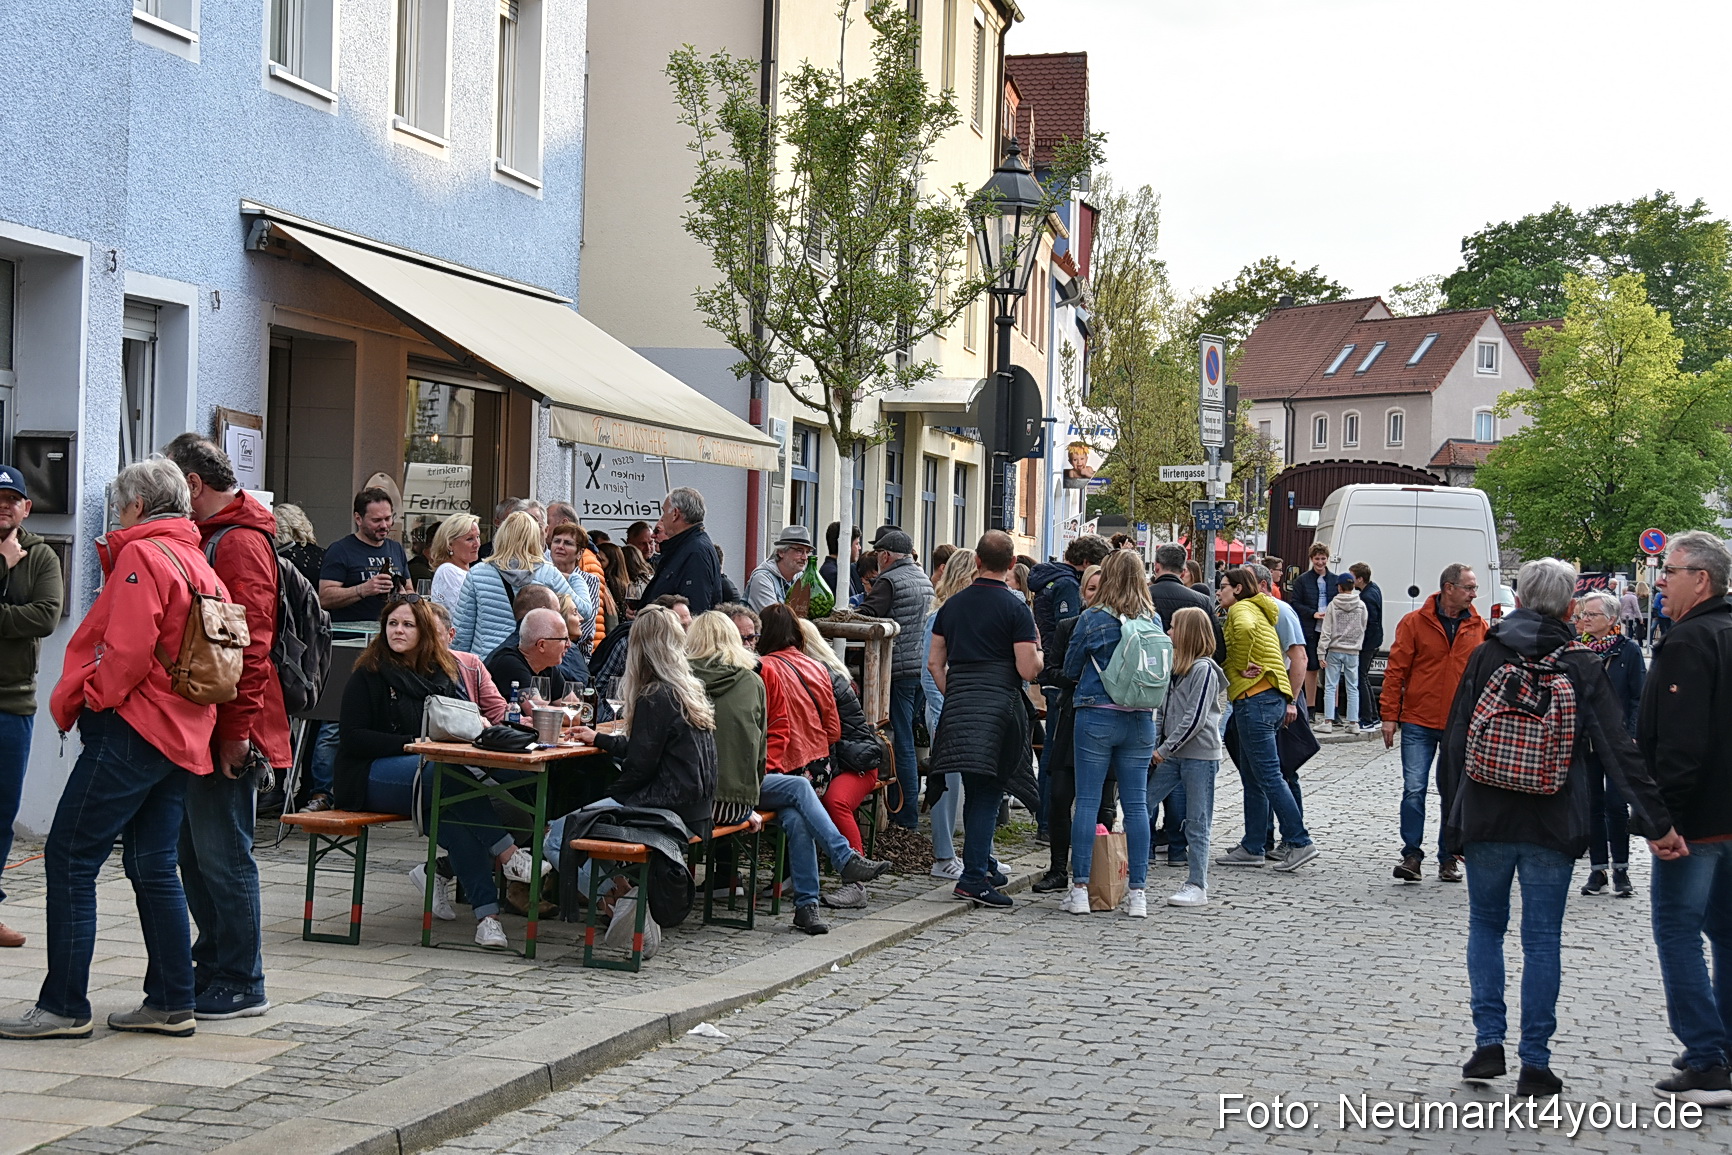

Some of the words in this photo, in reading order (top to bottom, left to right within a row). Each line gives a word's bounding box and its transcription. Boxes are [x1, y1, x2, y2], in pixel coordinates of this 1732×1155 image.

[1207, 387, 1219, 398] ZONE
[612, 422, 668, 455] GENUSSTHEKE
[1162, 468, 1206, 480] Hirtengasse
